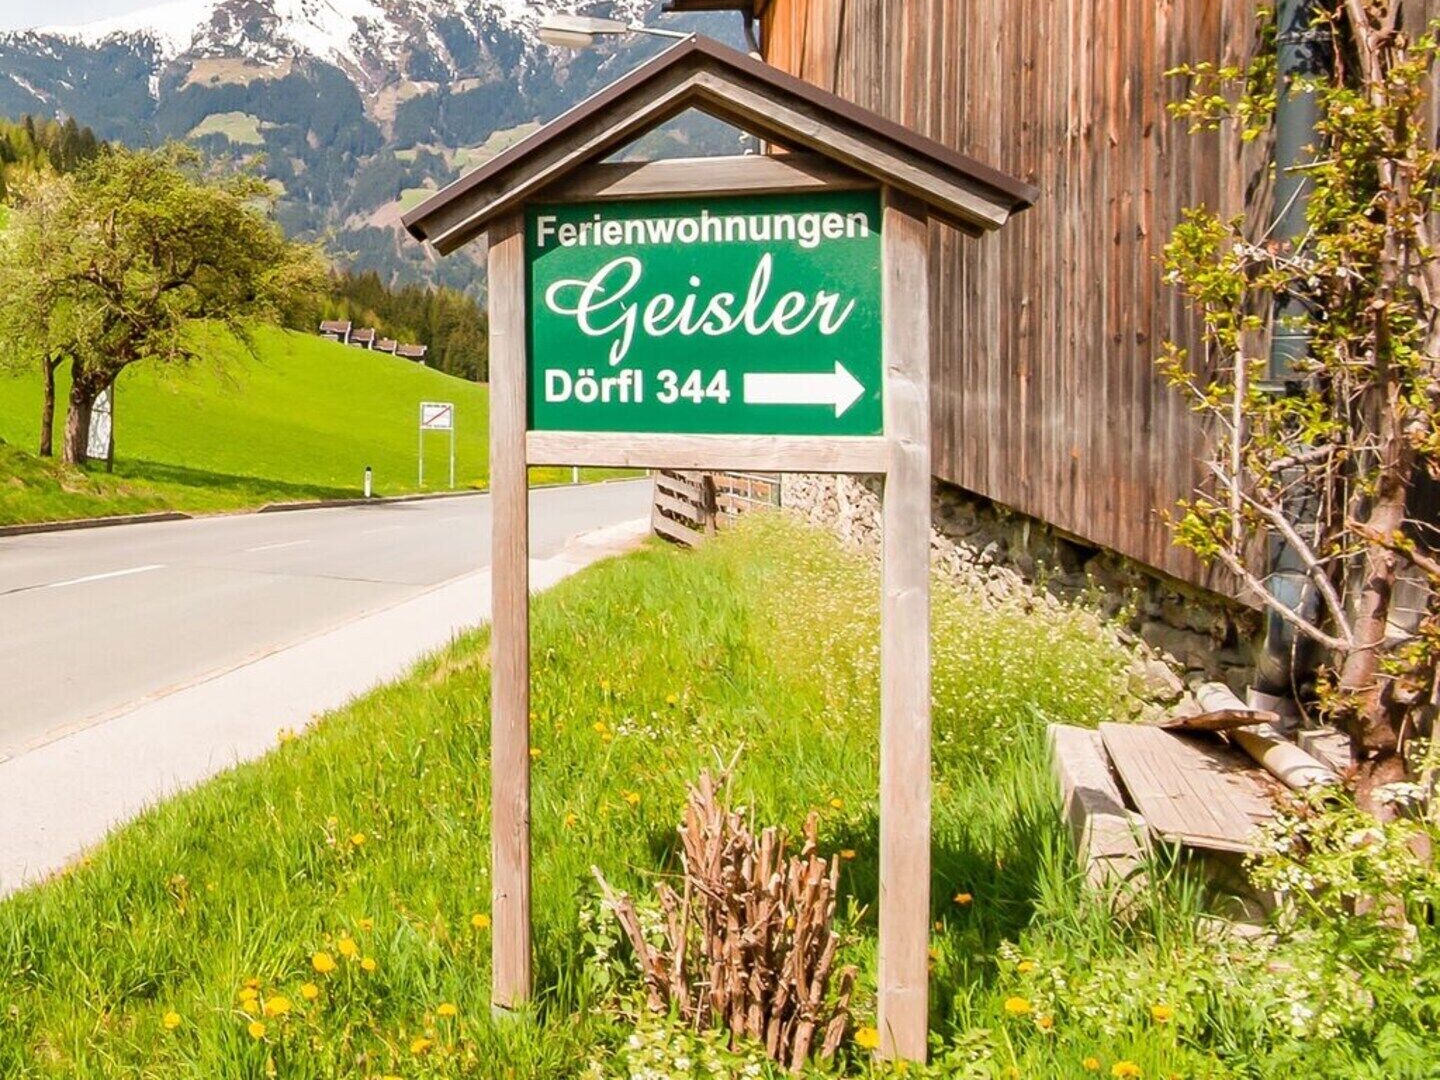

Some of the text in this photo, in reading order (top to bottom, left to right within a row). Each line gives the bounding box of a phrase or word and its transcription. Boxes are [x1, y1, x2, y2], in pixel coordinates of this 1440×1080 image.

[536, 210, 869, 248] Ferienwohnungen
[545, 252, 856, 366] Geisler
[544, 368, 731, 405] Dörfl 344
